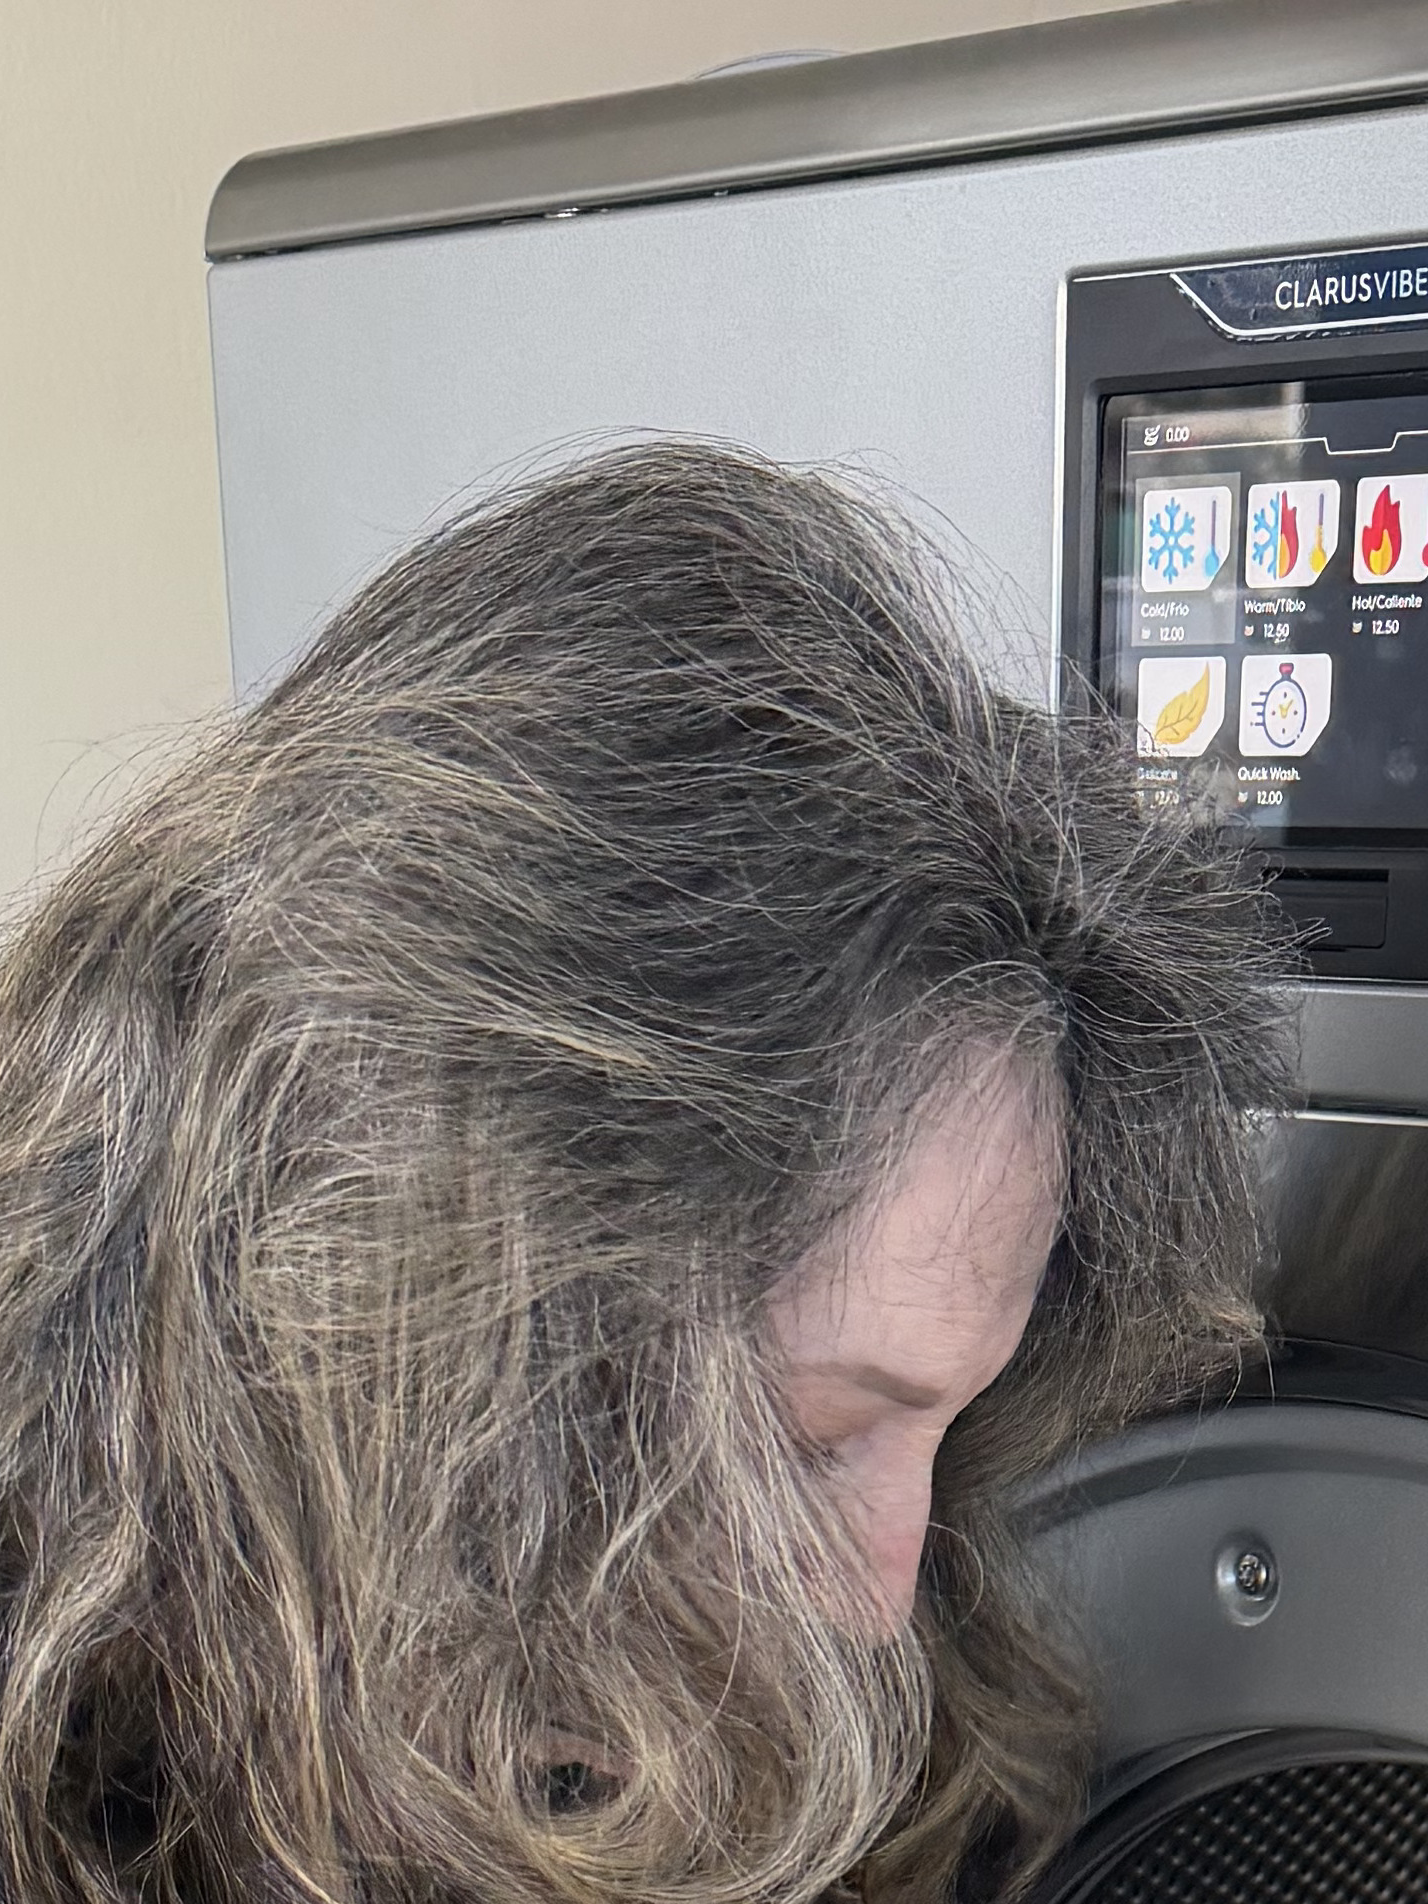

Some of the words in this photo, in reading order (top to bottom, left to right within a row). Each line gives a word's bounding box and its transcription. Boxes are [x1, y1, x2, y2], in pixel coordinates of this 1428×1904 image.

[1275, 267, 1428, 310] CLARUSVIBE
[1372, 619, 1400, 635] 12.50
[1238, 767, 1268, 781] Quick
[1257, 790, 1283, 806] 12.00
